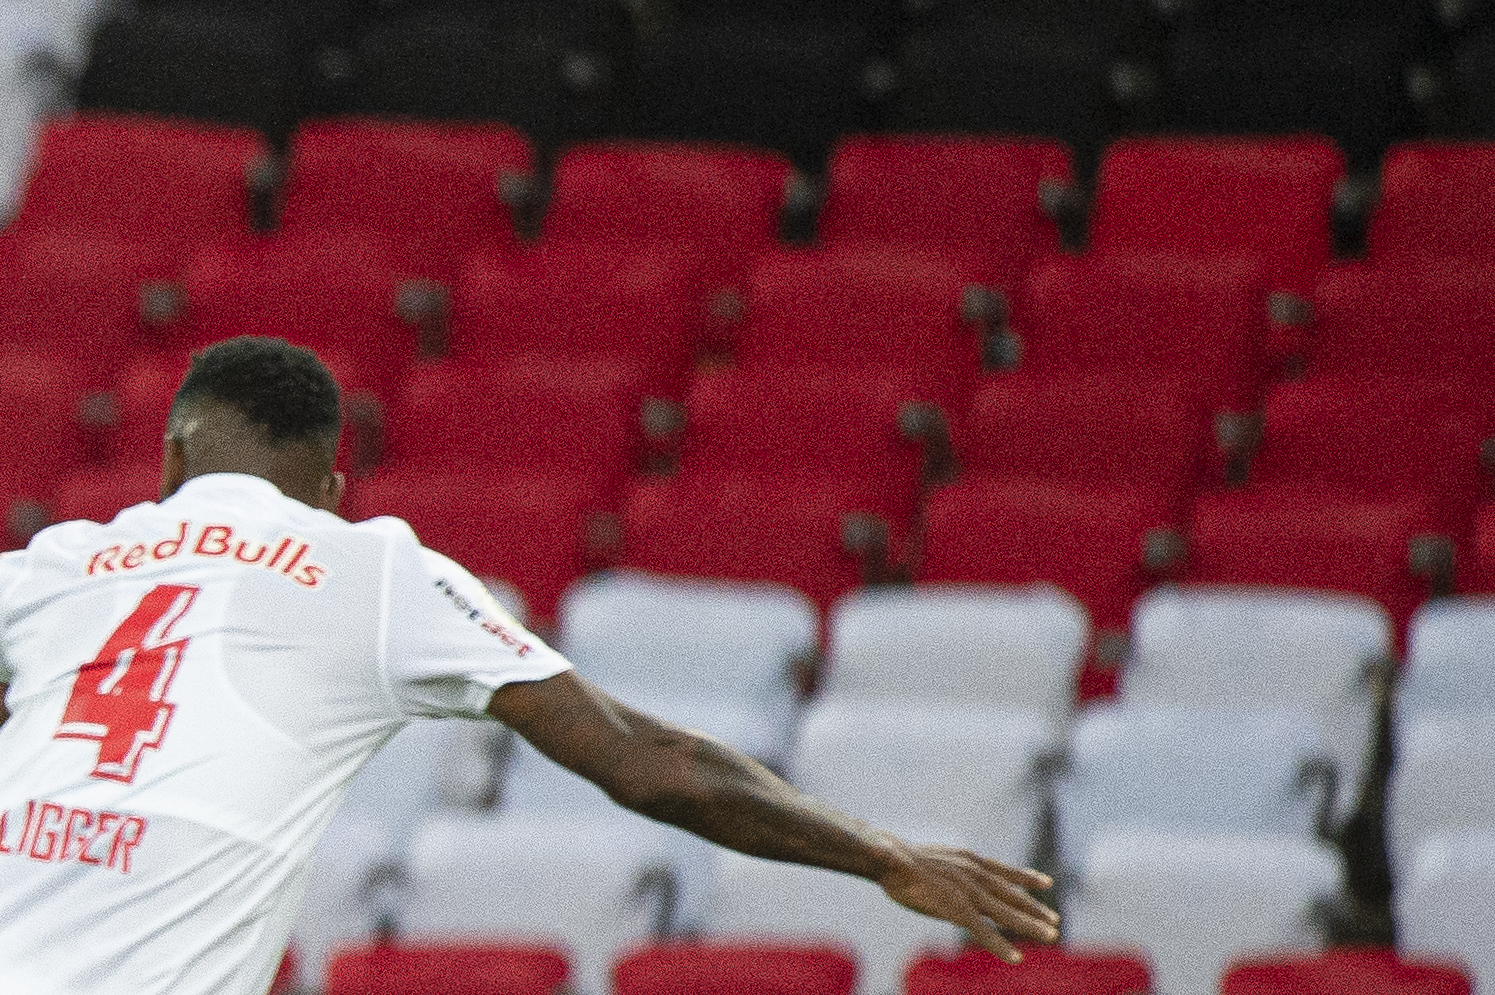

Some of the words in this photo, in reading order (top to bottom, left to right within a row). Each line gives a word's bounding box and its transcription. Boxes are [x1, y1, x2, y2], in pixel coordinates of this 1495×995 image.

[87, 519, 190, 577] Red
[194, 524, 328, 590] Bulls
[52, 583, 201, 784] 4
